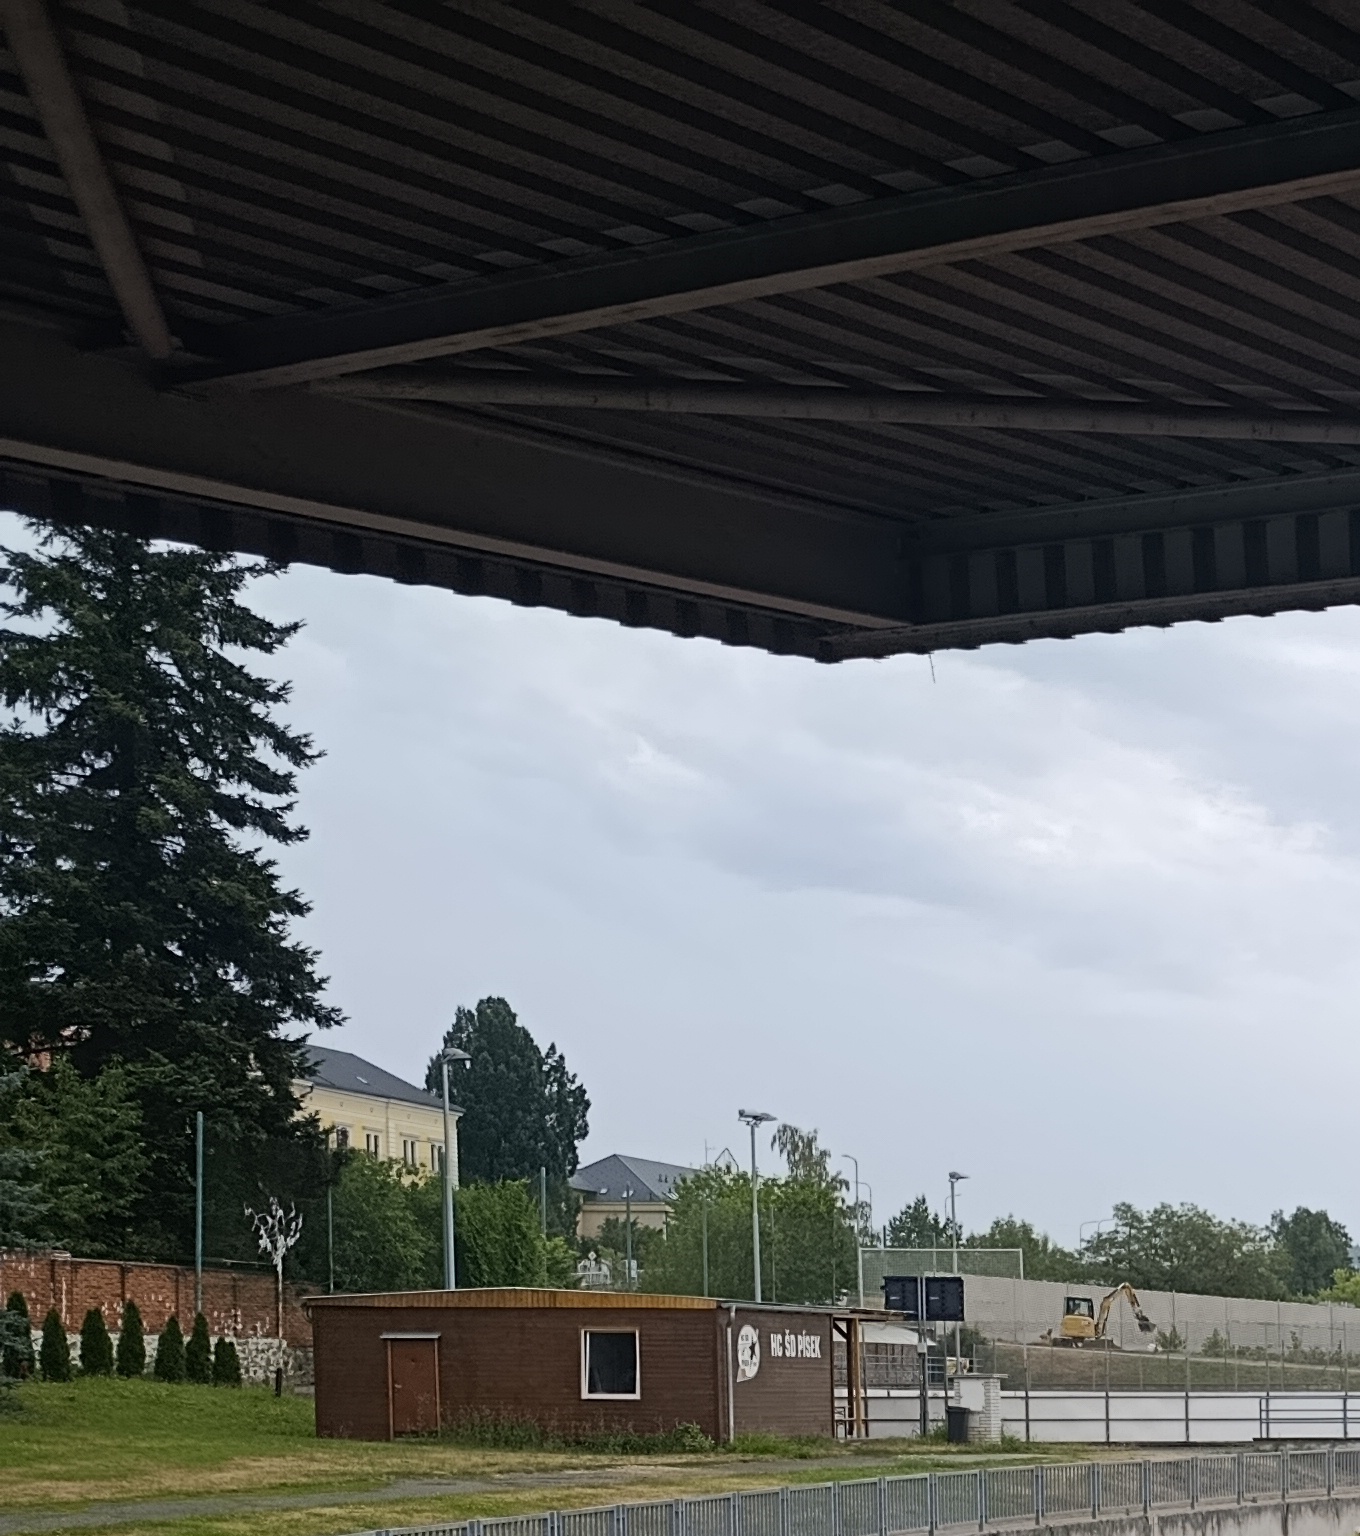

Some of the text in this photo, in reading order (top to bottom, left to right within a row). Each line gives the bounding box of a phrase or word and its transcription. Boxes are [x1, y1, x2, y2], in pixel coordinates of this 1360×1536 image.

[771, 1328, 822, 1358] HC ŠD PÍSEK
